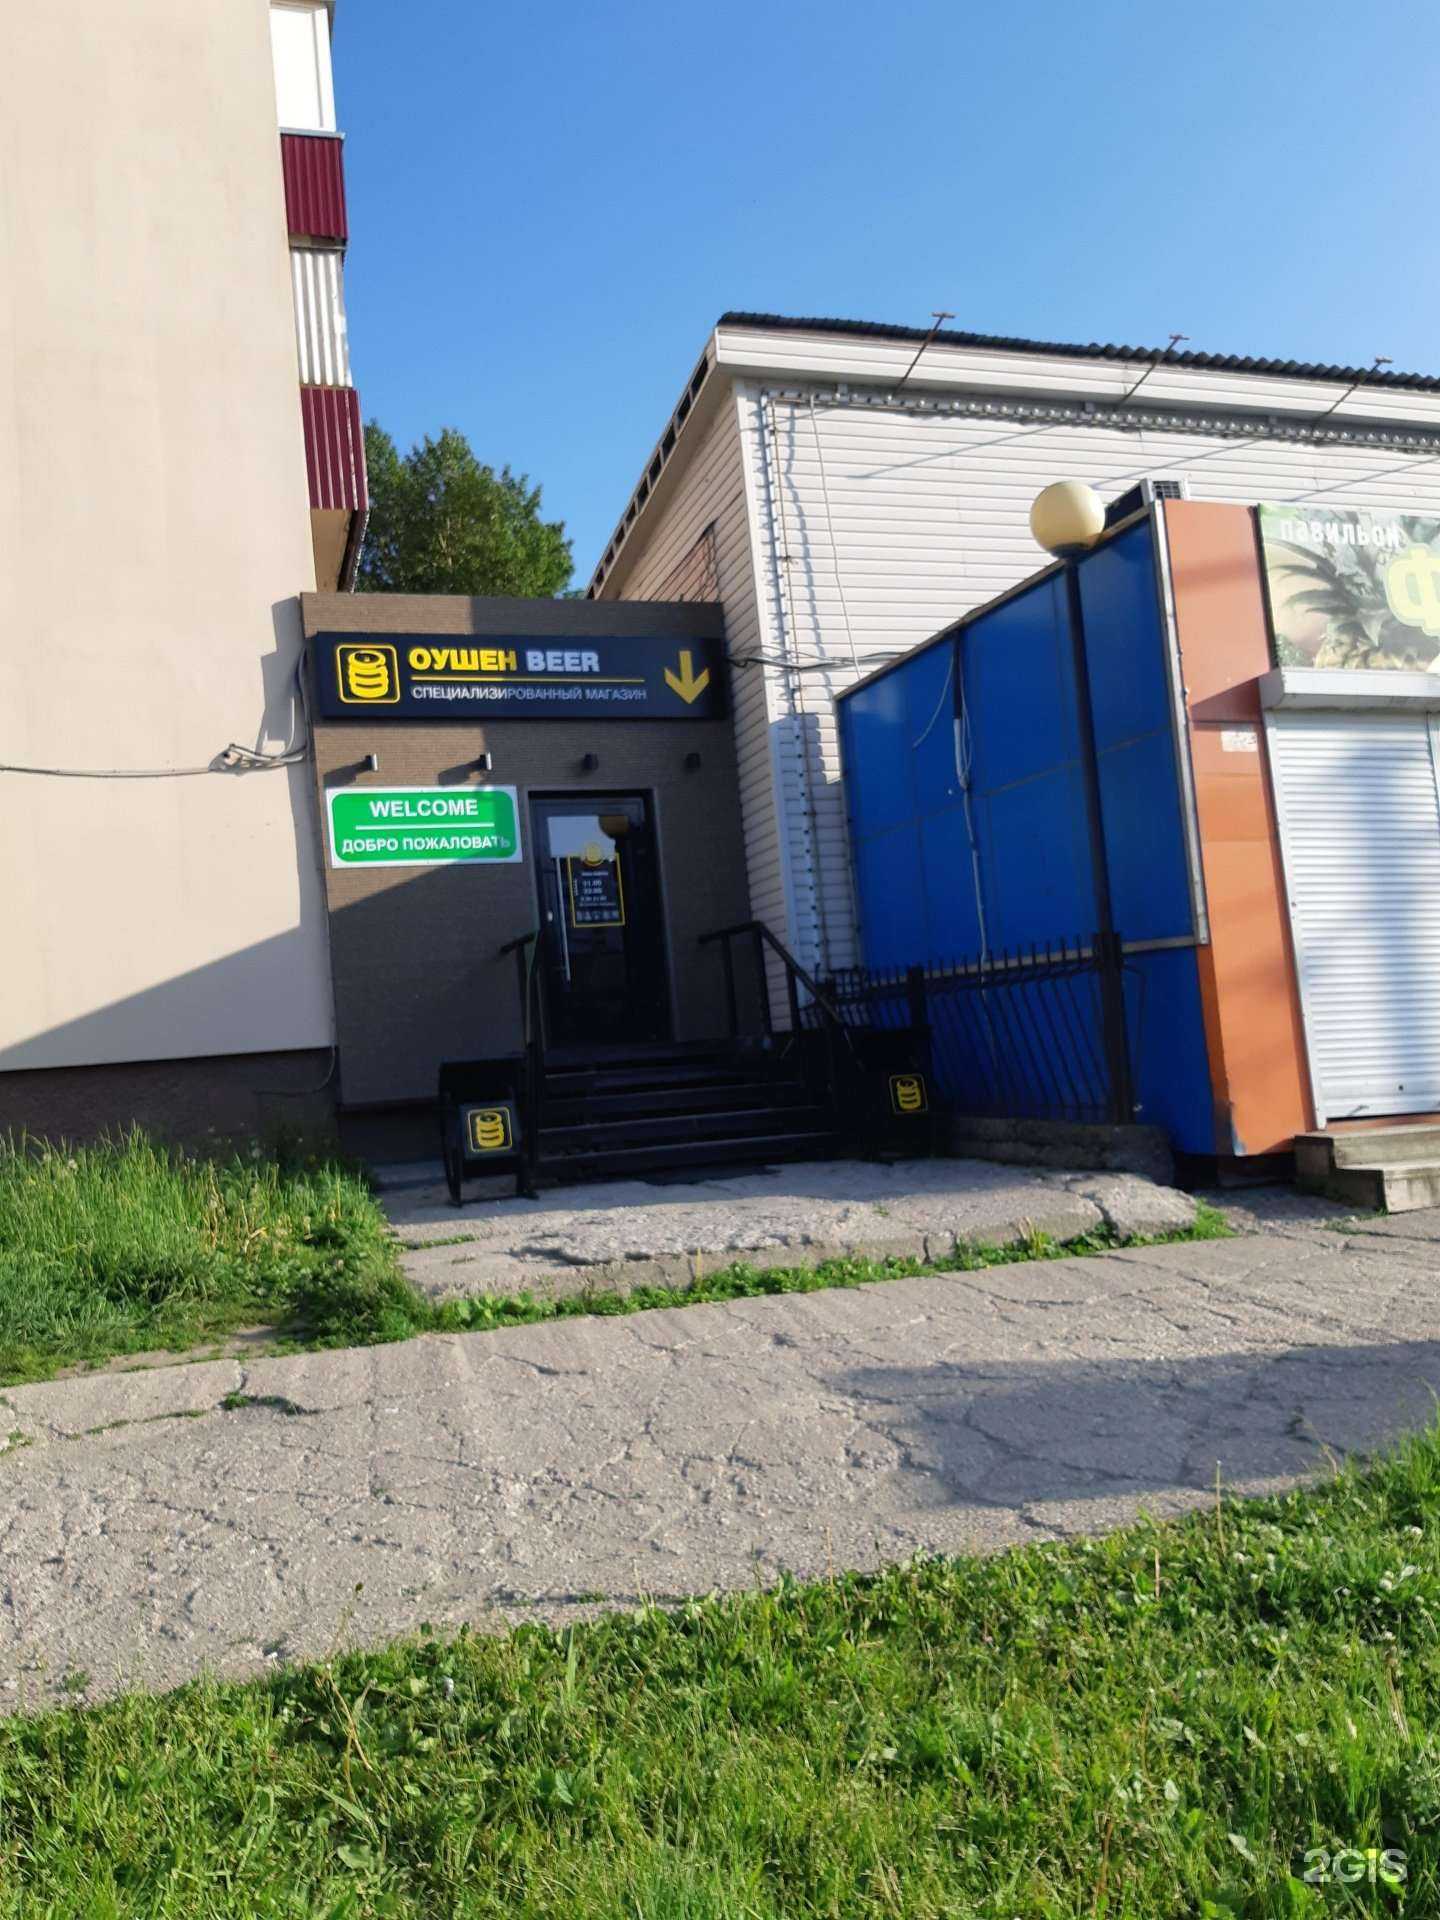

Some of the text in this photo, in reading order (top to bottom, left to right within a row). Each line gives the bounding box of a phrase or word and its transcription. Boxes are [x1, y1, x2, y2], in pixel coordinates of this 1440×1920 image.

[409, 647, 600, 672] ОУШЕН BEER
[412, 685, 647, 701] СПЕЦИАЛИЗИРОВАННЫЙ МАГАЗИН
[369, 798, 478, 818] WELCOME
[342, 835, 511, 854] ДОБРО ПОЖАЛОВАТЬ
